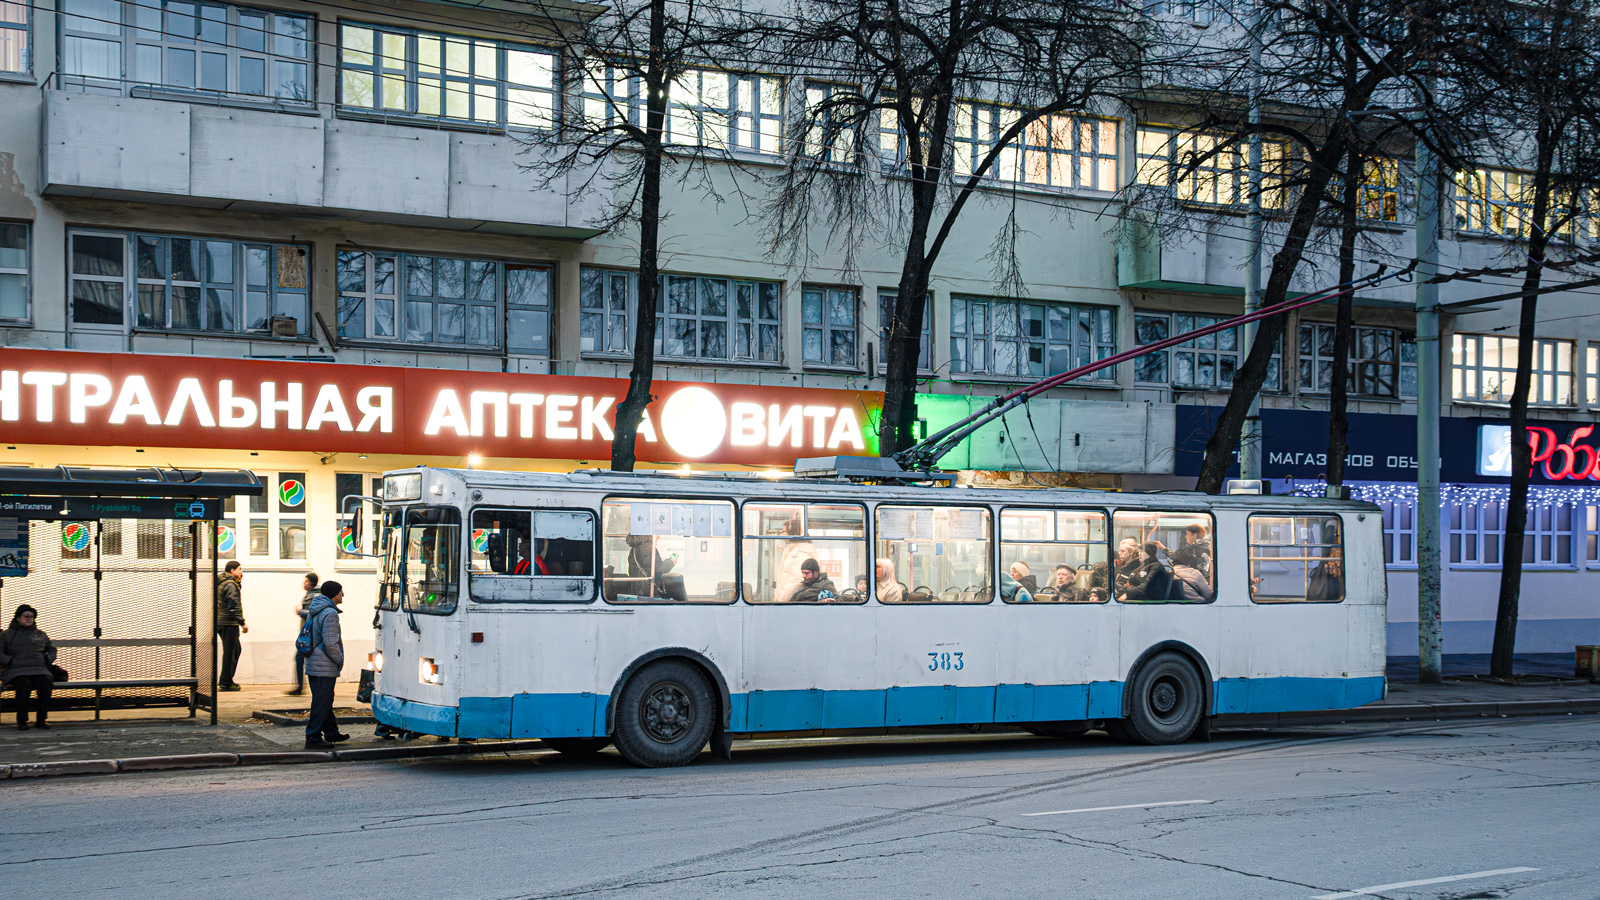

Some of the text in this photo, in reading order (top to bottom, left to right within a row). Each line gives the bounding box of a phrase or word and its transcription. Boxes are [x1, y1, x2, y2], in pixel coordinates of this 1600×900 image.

[730, 402, 864, 449] ВИТА
[1269, 451, 1442, 469] МАГАЗНОВ ОБУ
[15, 502, 52, 510] Пятилетки
[928, 652, 964, 671] 383
